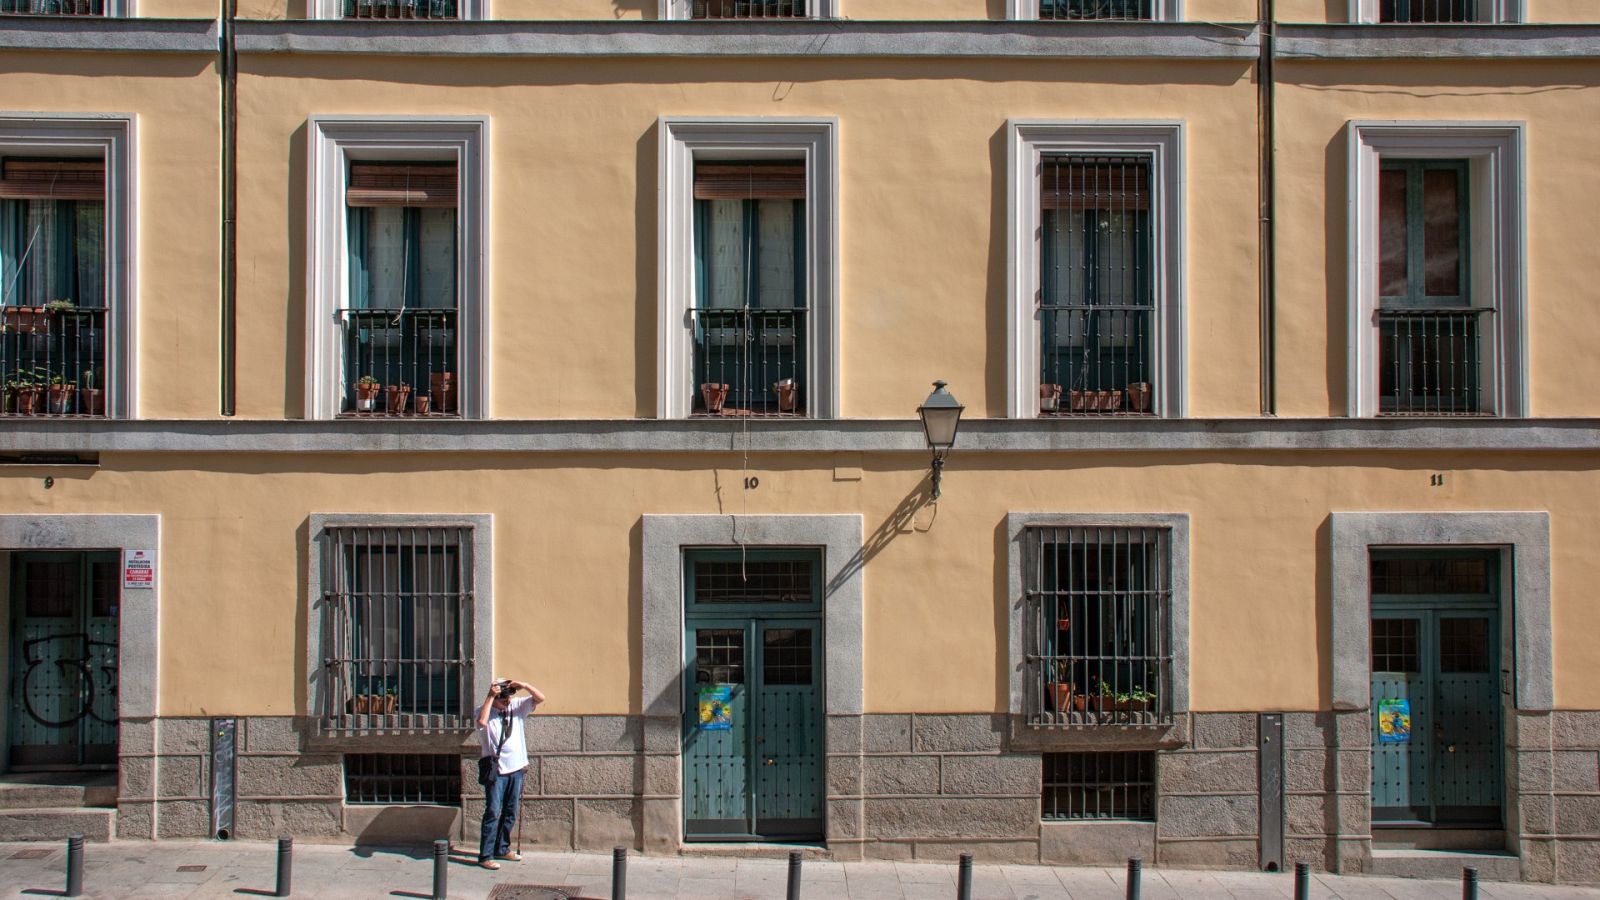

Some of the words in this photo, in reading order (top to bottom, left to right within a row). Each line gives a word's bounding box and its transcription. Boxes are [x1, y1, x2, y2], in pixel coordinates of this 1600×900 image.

[44, 476, 54, 489] 9
[744, 476, 759, 489] 10
[1430, 474, 1443, 486] 11
